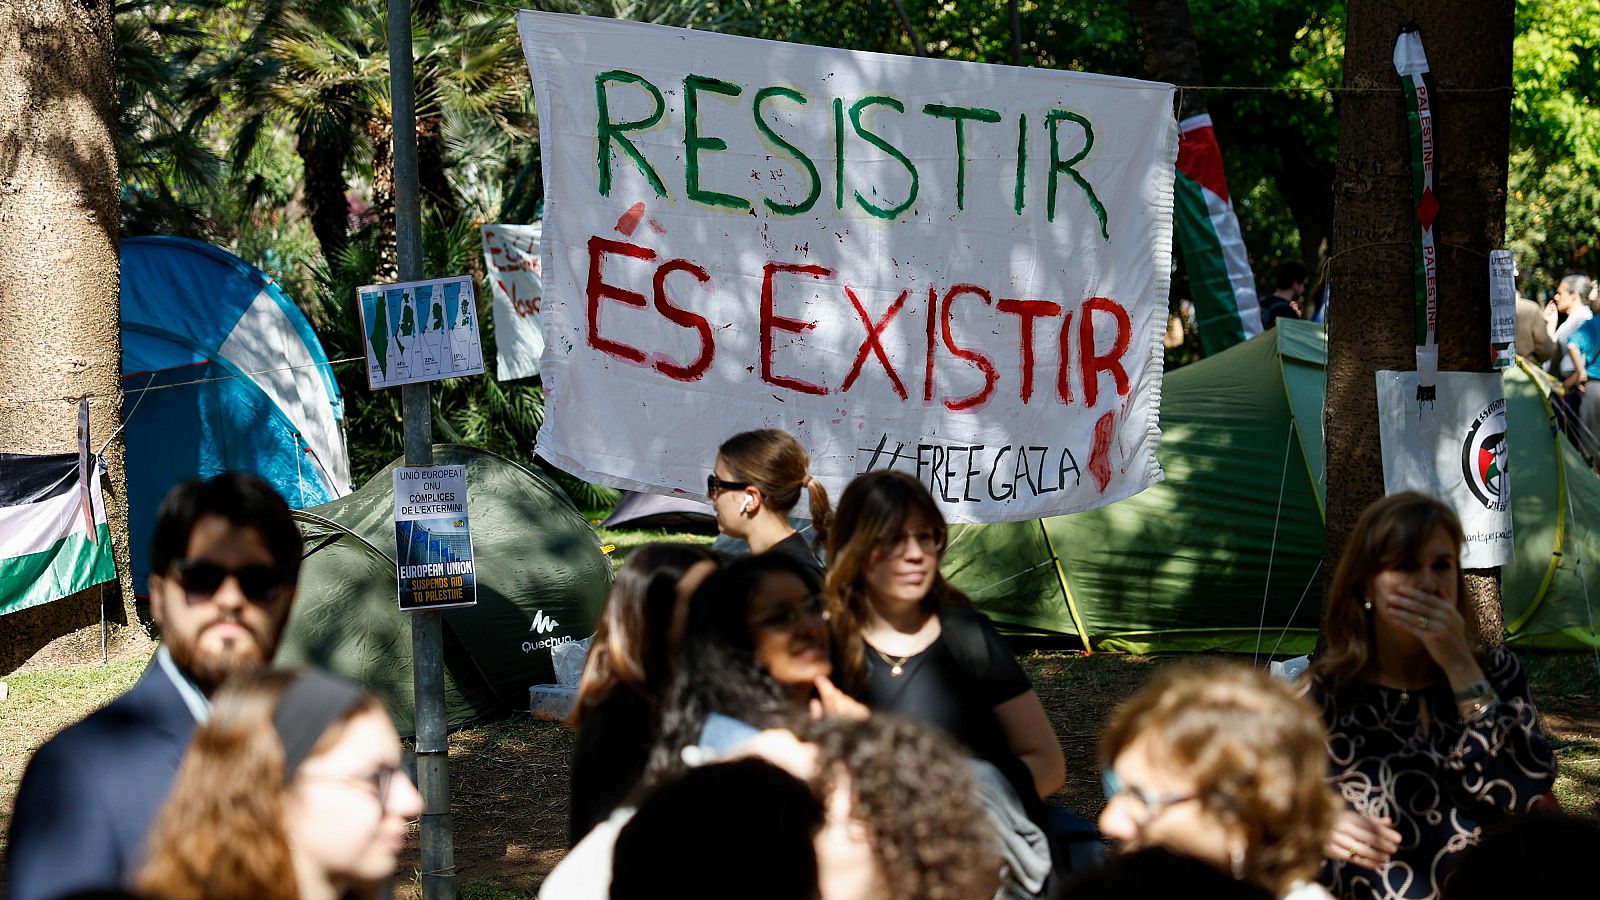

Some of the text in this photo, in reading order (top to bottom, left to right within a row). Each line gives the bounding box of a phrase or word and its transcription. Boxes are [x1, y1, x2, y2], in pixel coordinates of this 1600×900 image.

[1417, 86, 1433, 172] PALESTINE
[595, 69, 1109, 241] RESISTIR
[1423, 245, 1436, 332] PALESTINE
[586, 201, 1133, 412] ÉS EXISTIR
[400, 470, 420, 481] UNIÓ
[421, 469, 459, 479] EUROPEA
[423, 482, 441, 491] ONU
[409, 492, 455, 503] CÒMPLICES
[401, 503, 463, 515] DE L'EXTERMINI
[400, 560, 473, 579] EUROPEAN UNION
[411, 576, 463, 591] SUSPENDS AID
[413, 588, 464, 603] TO PALESTINE
